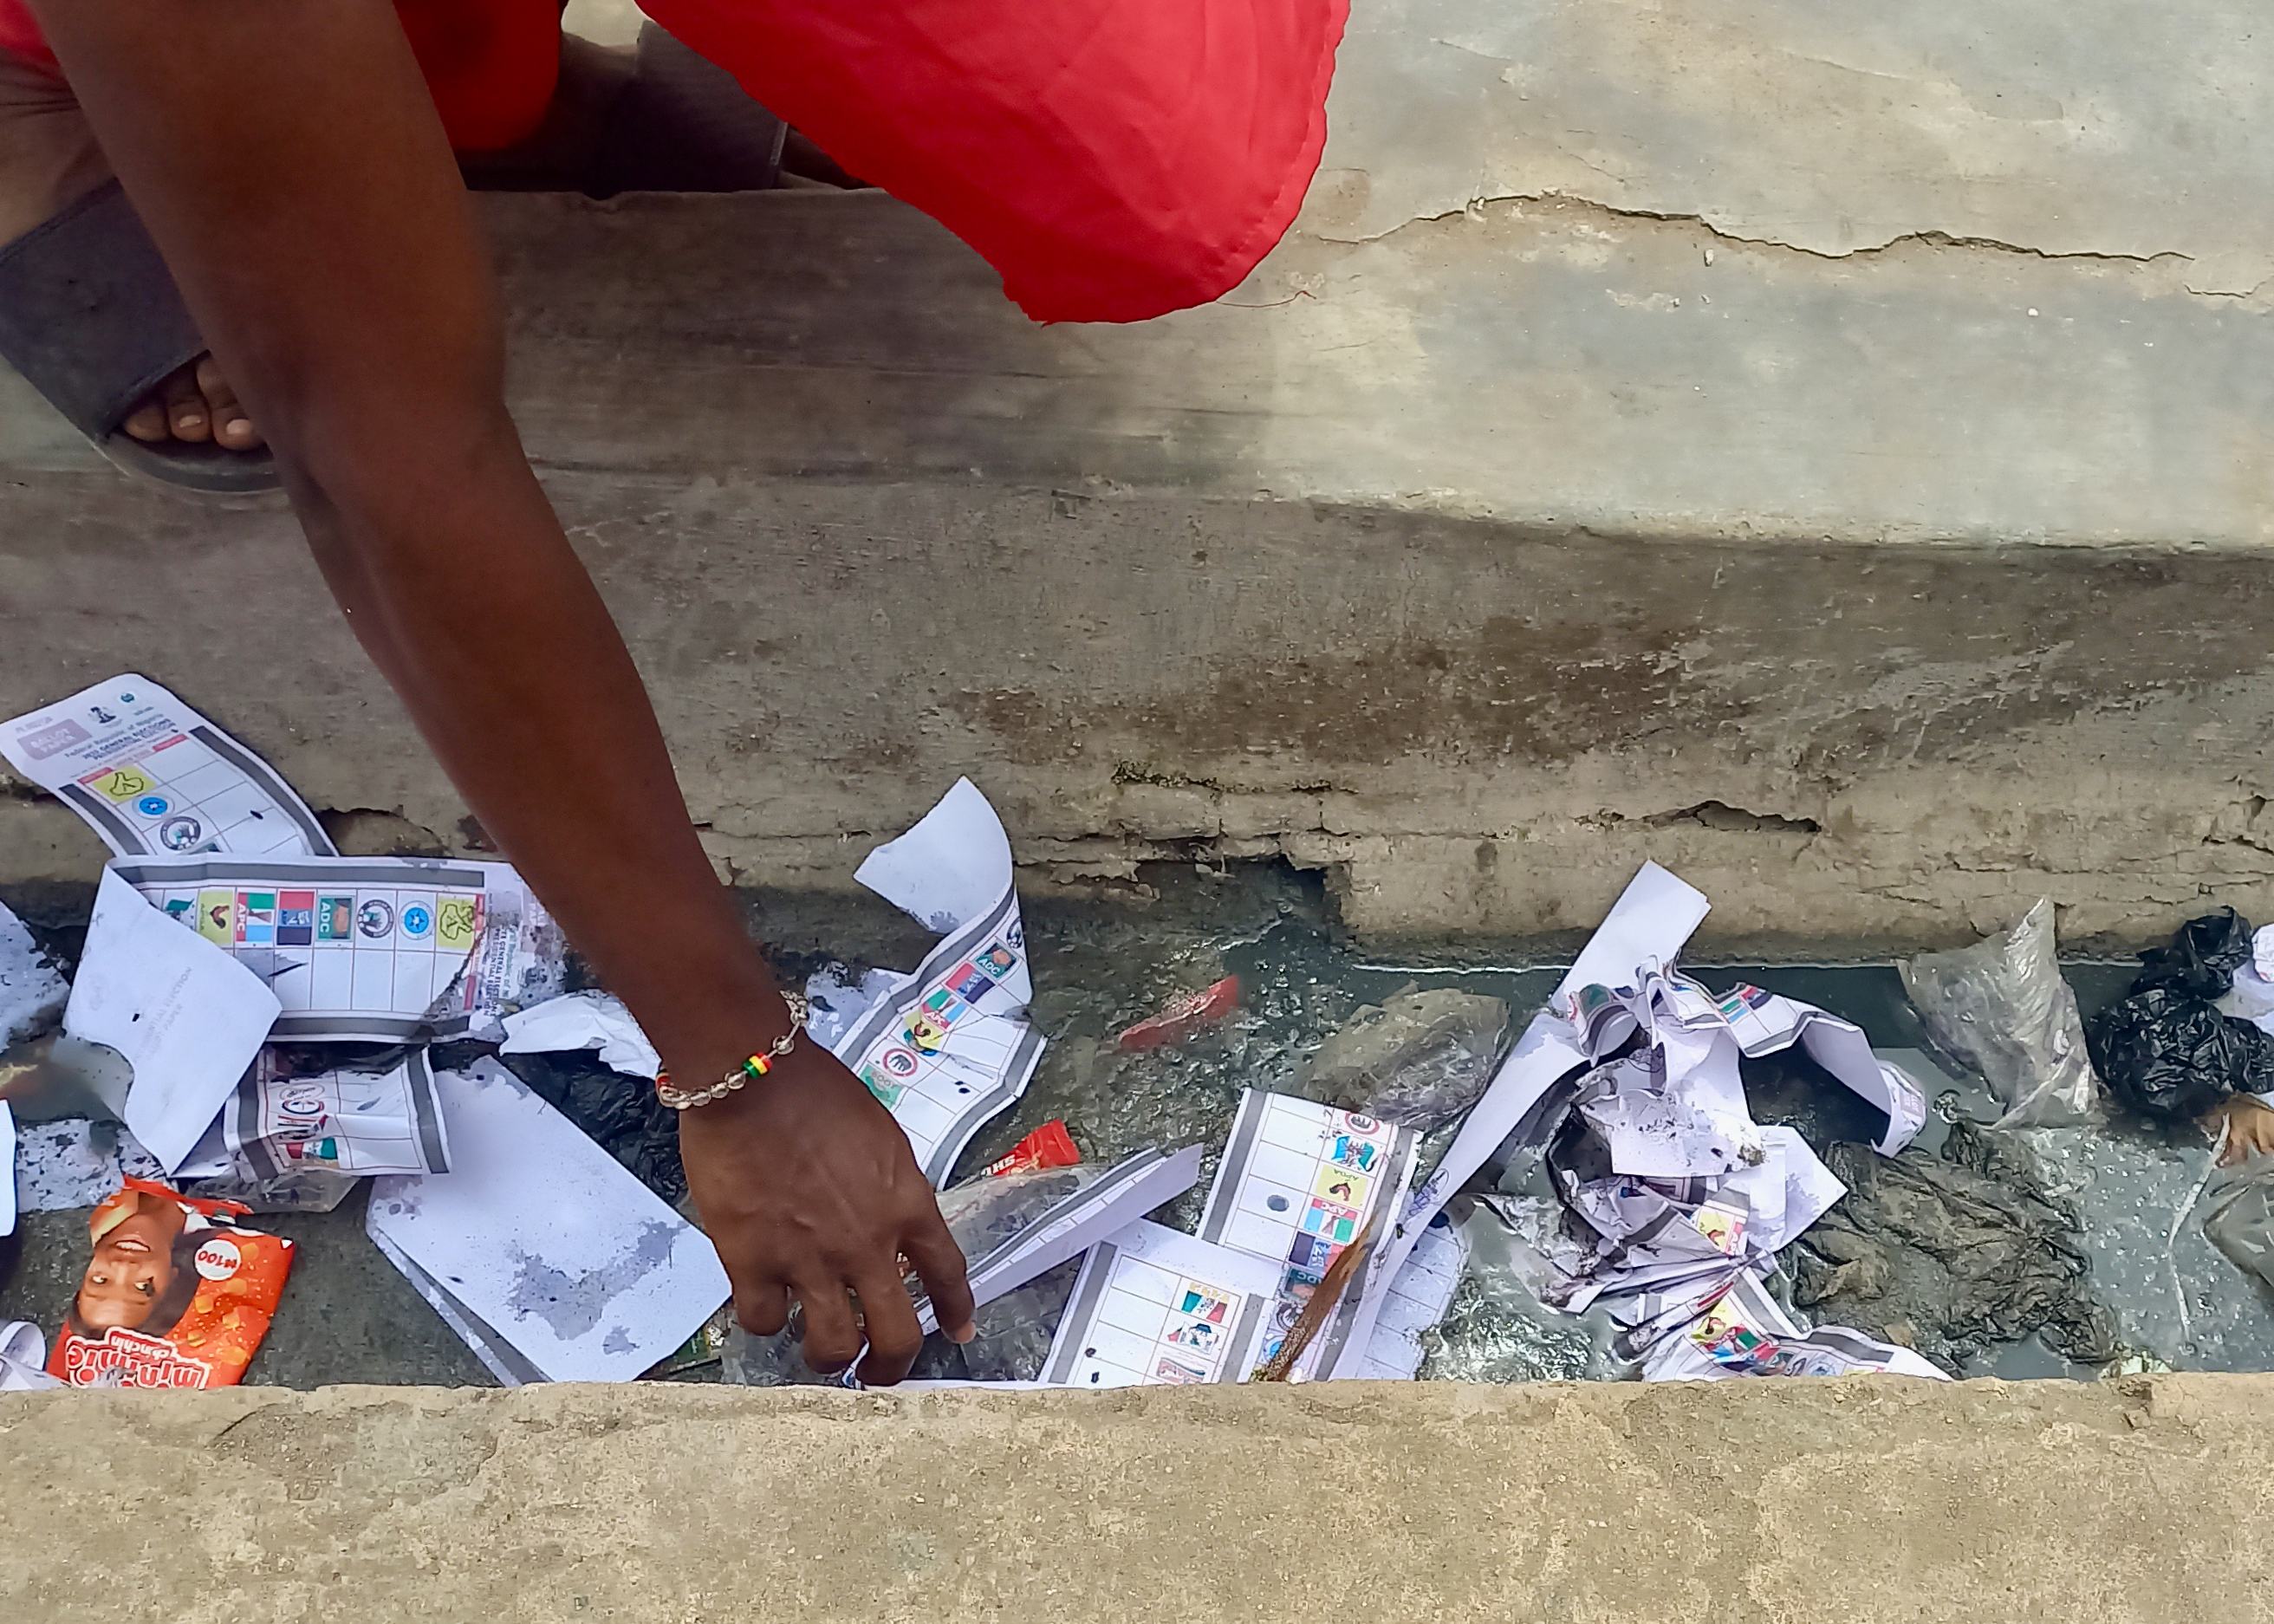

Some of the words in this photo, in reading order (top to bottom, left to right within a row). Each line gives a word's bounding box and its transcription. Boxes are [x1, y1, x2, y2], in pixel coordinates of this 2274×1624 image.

[237, 903, 246, 932] APC
[320, 902, 330, 932] ADC
[978, 958, 1000, 974] ADC
[1320, 1201, 1348, 1216] APC
[111, 1335, 170, 1360] chinchin
